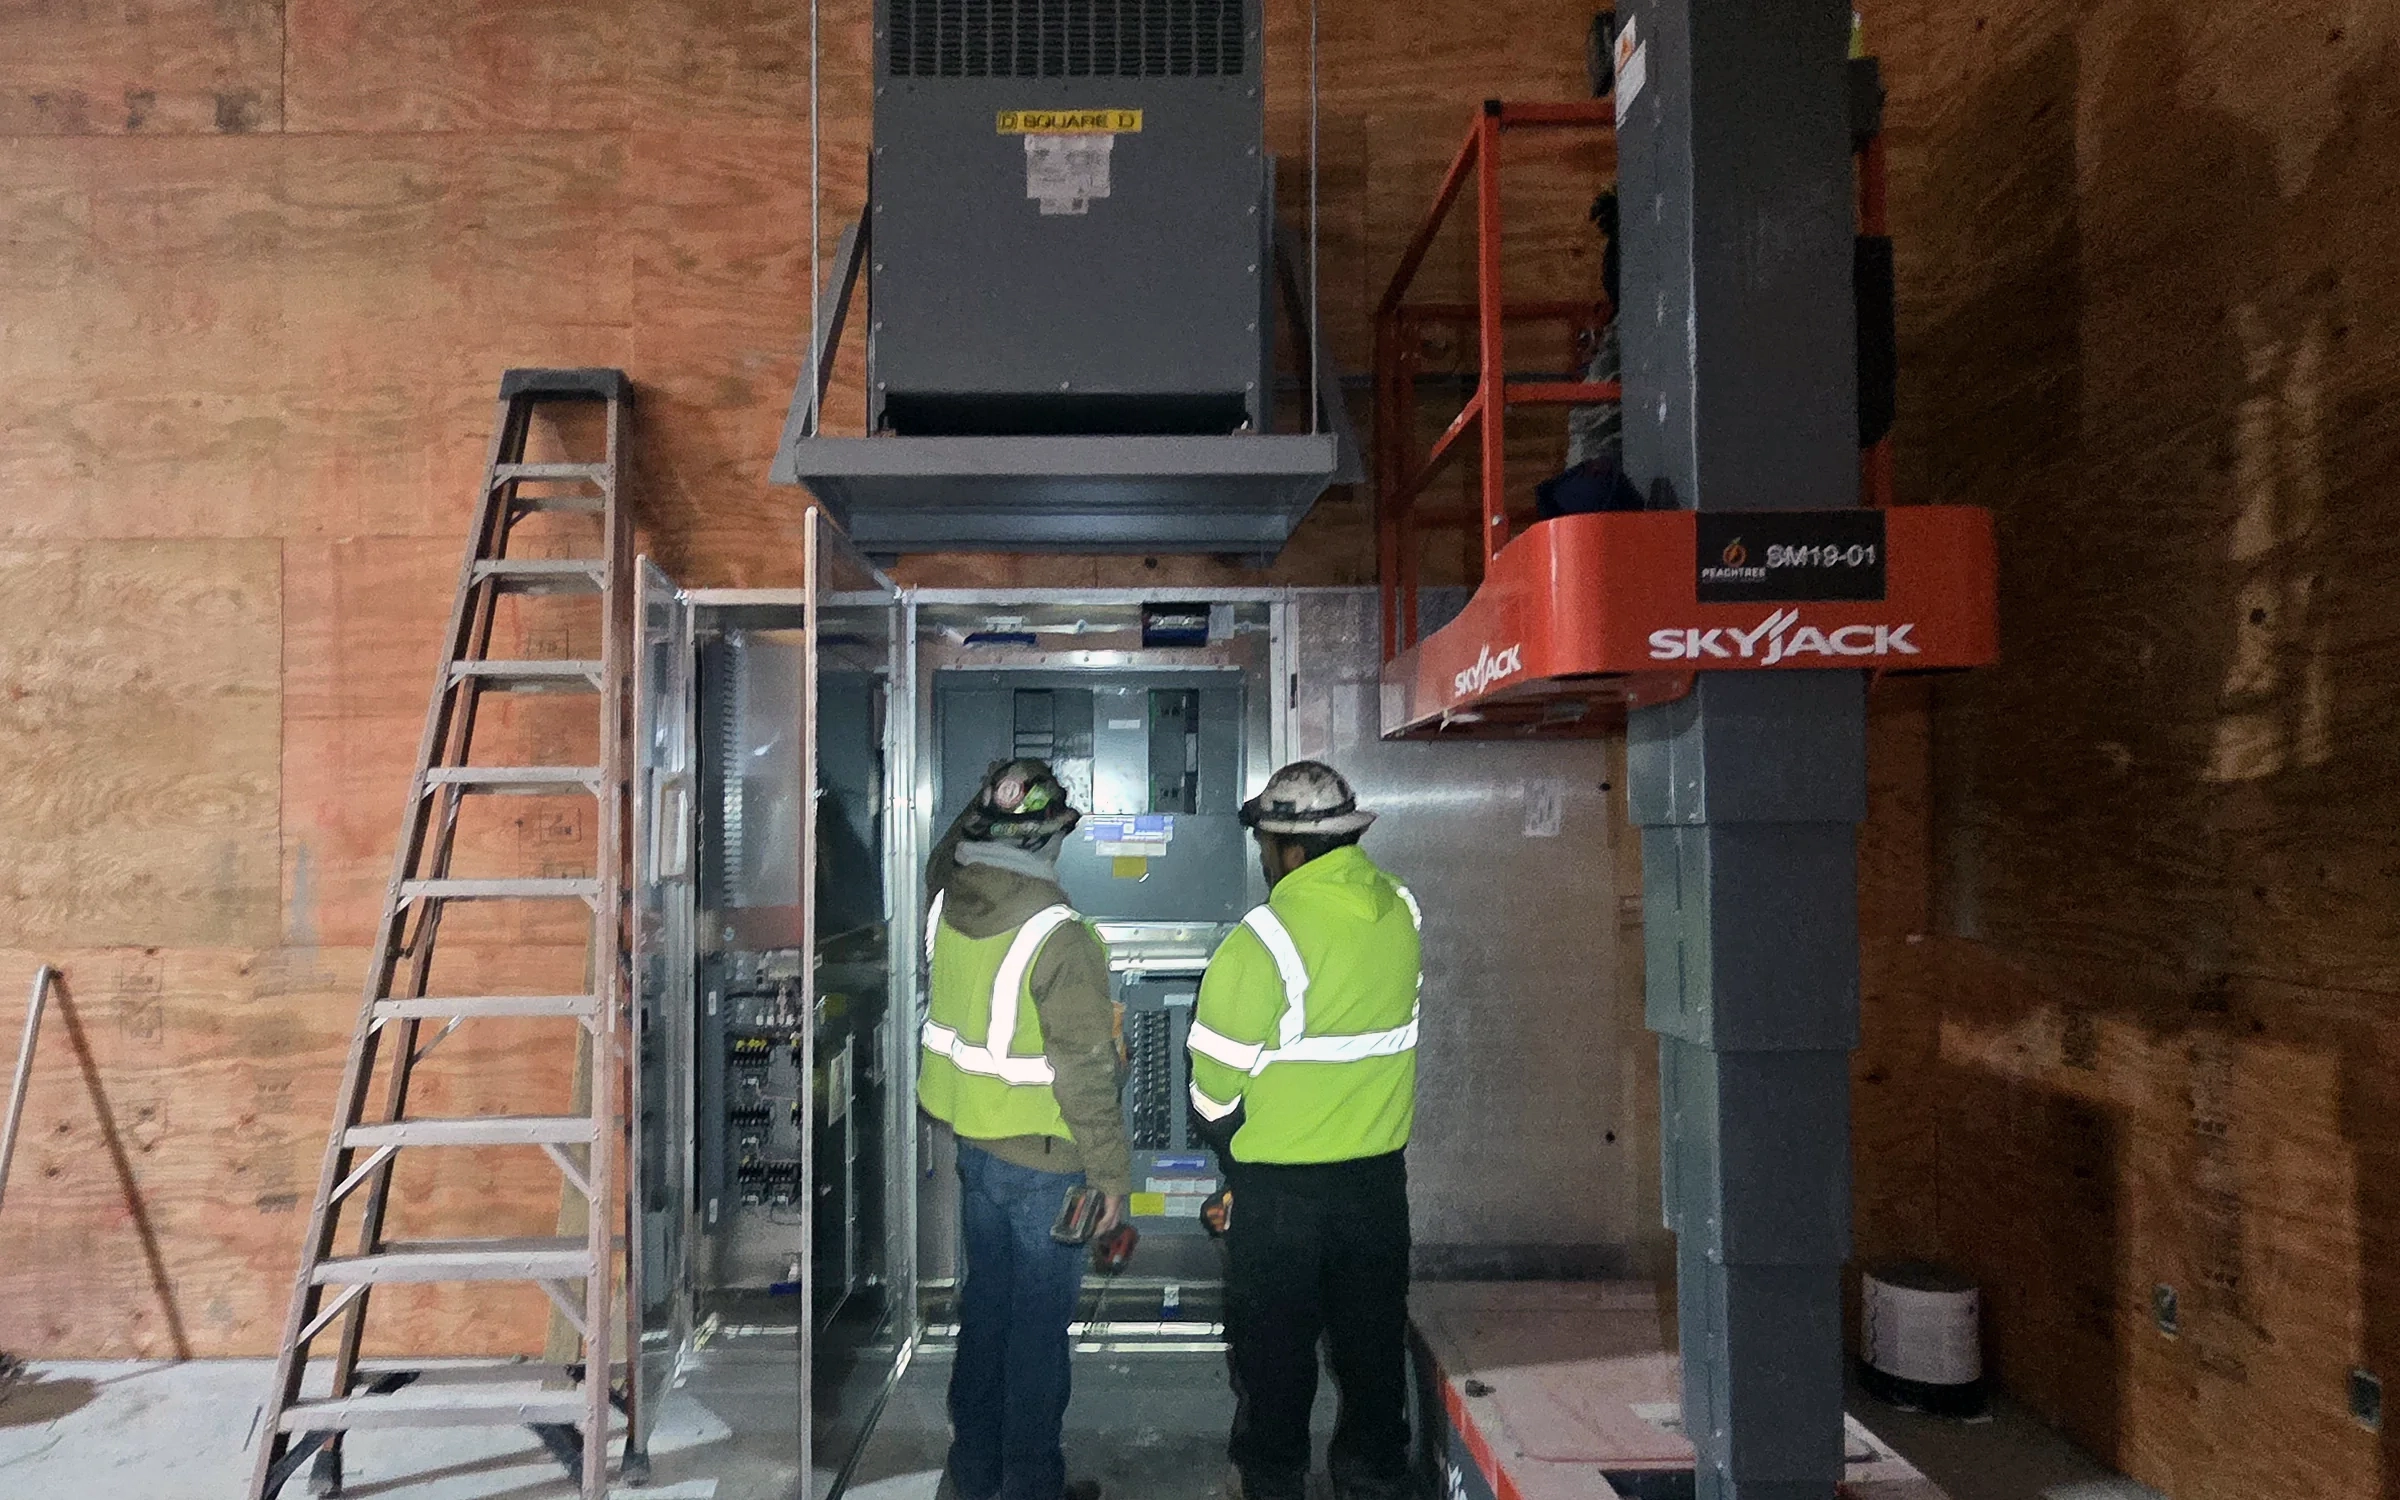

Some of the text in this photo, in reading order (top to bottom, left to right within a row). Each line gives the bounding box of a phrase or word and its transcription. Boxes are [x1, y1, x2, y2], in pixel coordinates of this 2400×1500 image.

[1023, 114, 1109, 129] SQUARE
[1118, 112, 1135, 128] D
[1766, 543, 1876, 568] SM19-01
[1701, 567, 1766, 578] PEACHTREE
[1649, 607, 1920, 666] SKYJACK
[1454, 643, 1521, 697] SKYJACK
